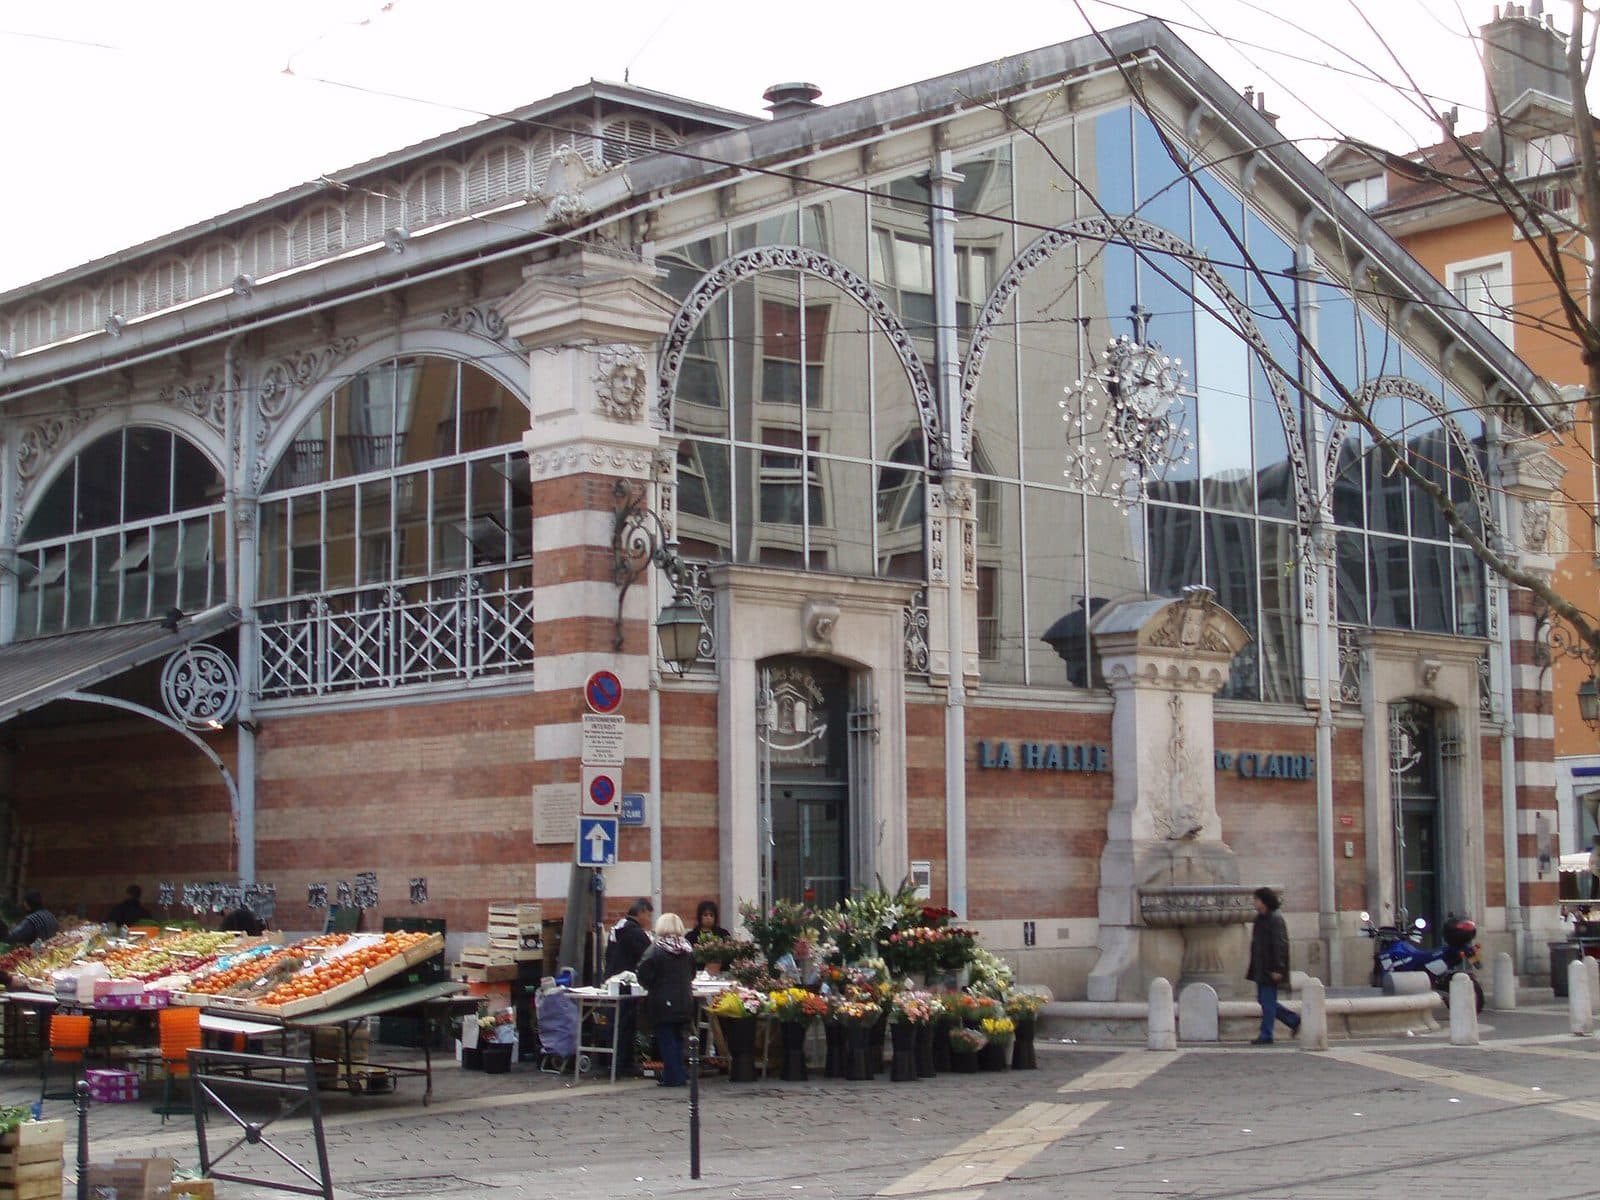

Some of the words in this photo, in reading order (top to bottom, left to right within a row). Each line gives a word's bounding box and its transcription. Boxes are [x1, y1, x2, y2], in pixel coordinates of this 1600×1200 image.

[977, 740, 1014, 769] LA
[1021, 743, 1107, 772] HALLE
[1237, 752, 1313, 779] CLAIRE
